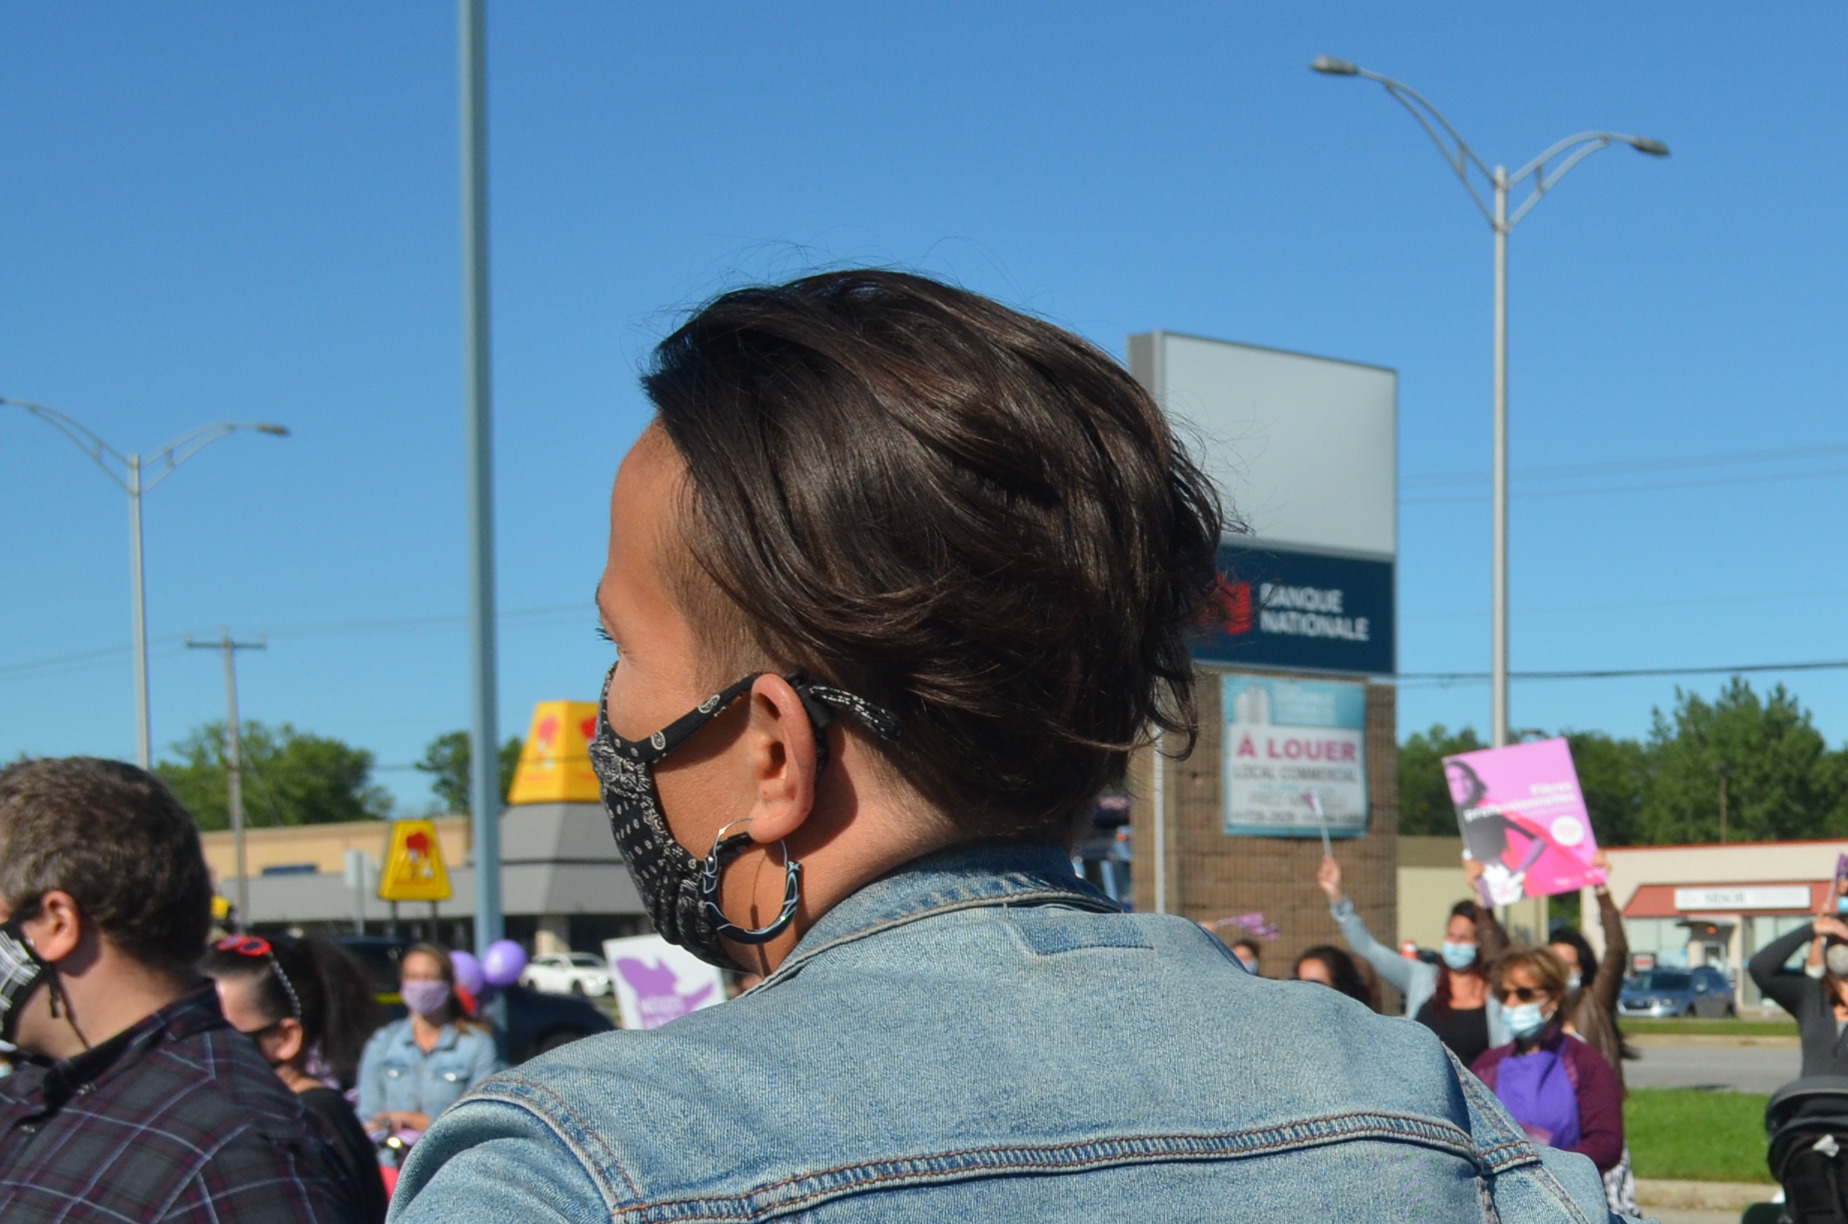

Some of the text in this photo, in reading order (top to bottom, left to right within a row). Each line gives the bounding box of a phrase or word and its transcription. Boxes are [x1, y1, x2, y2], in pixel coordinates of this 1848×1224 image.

[1260, 582, 1343, 613] BANQUE
[1260, 610, 1369, 641] NATIONALE
[1267, 738, 1356, 761] LOUER
